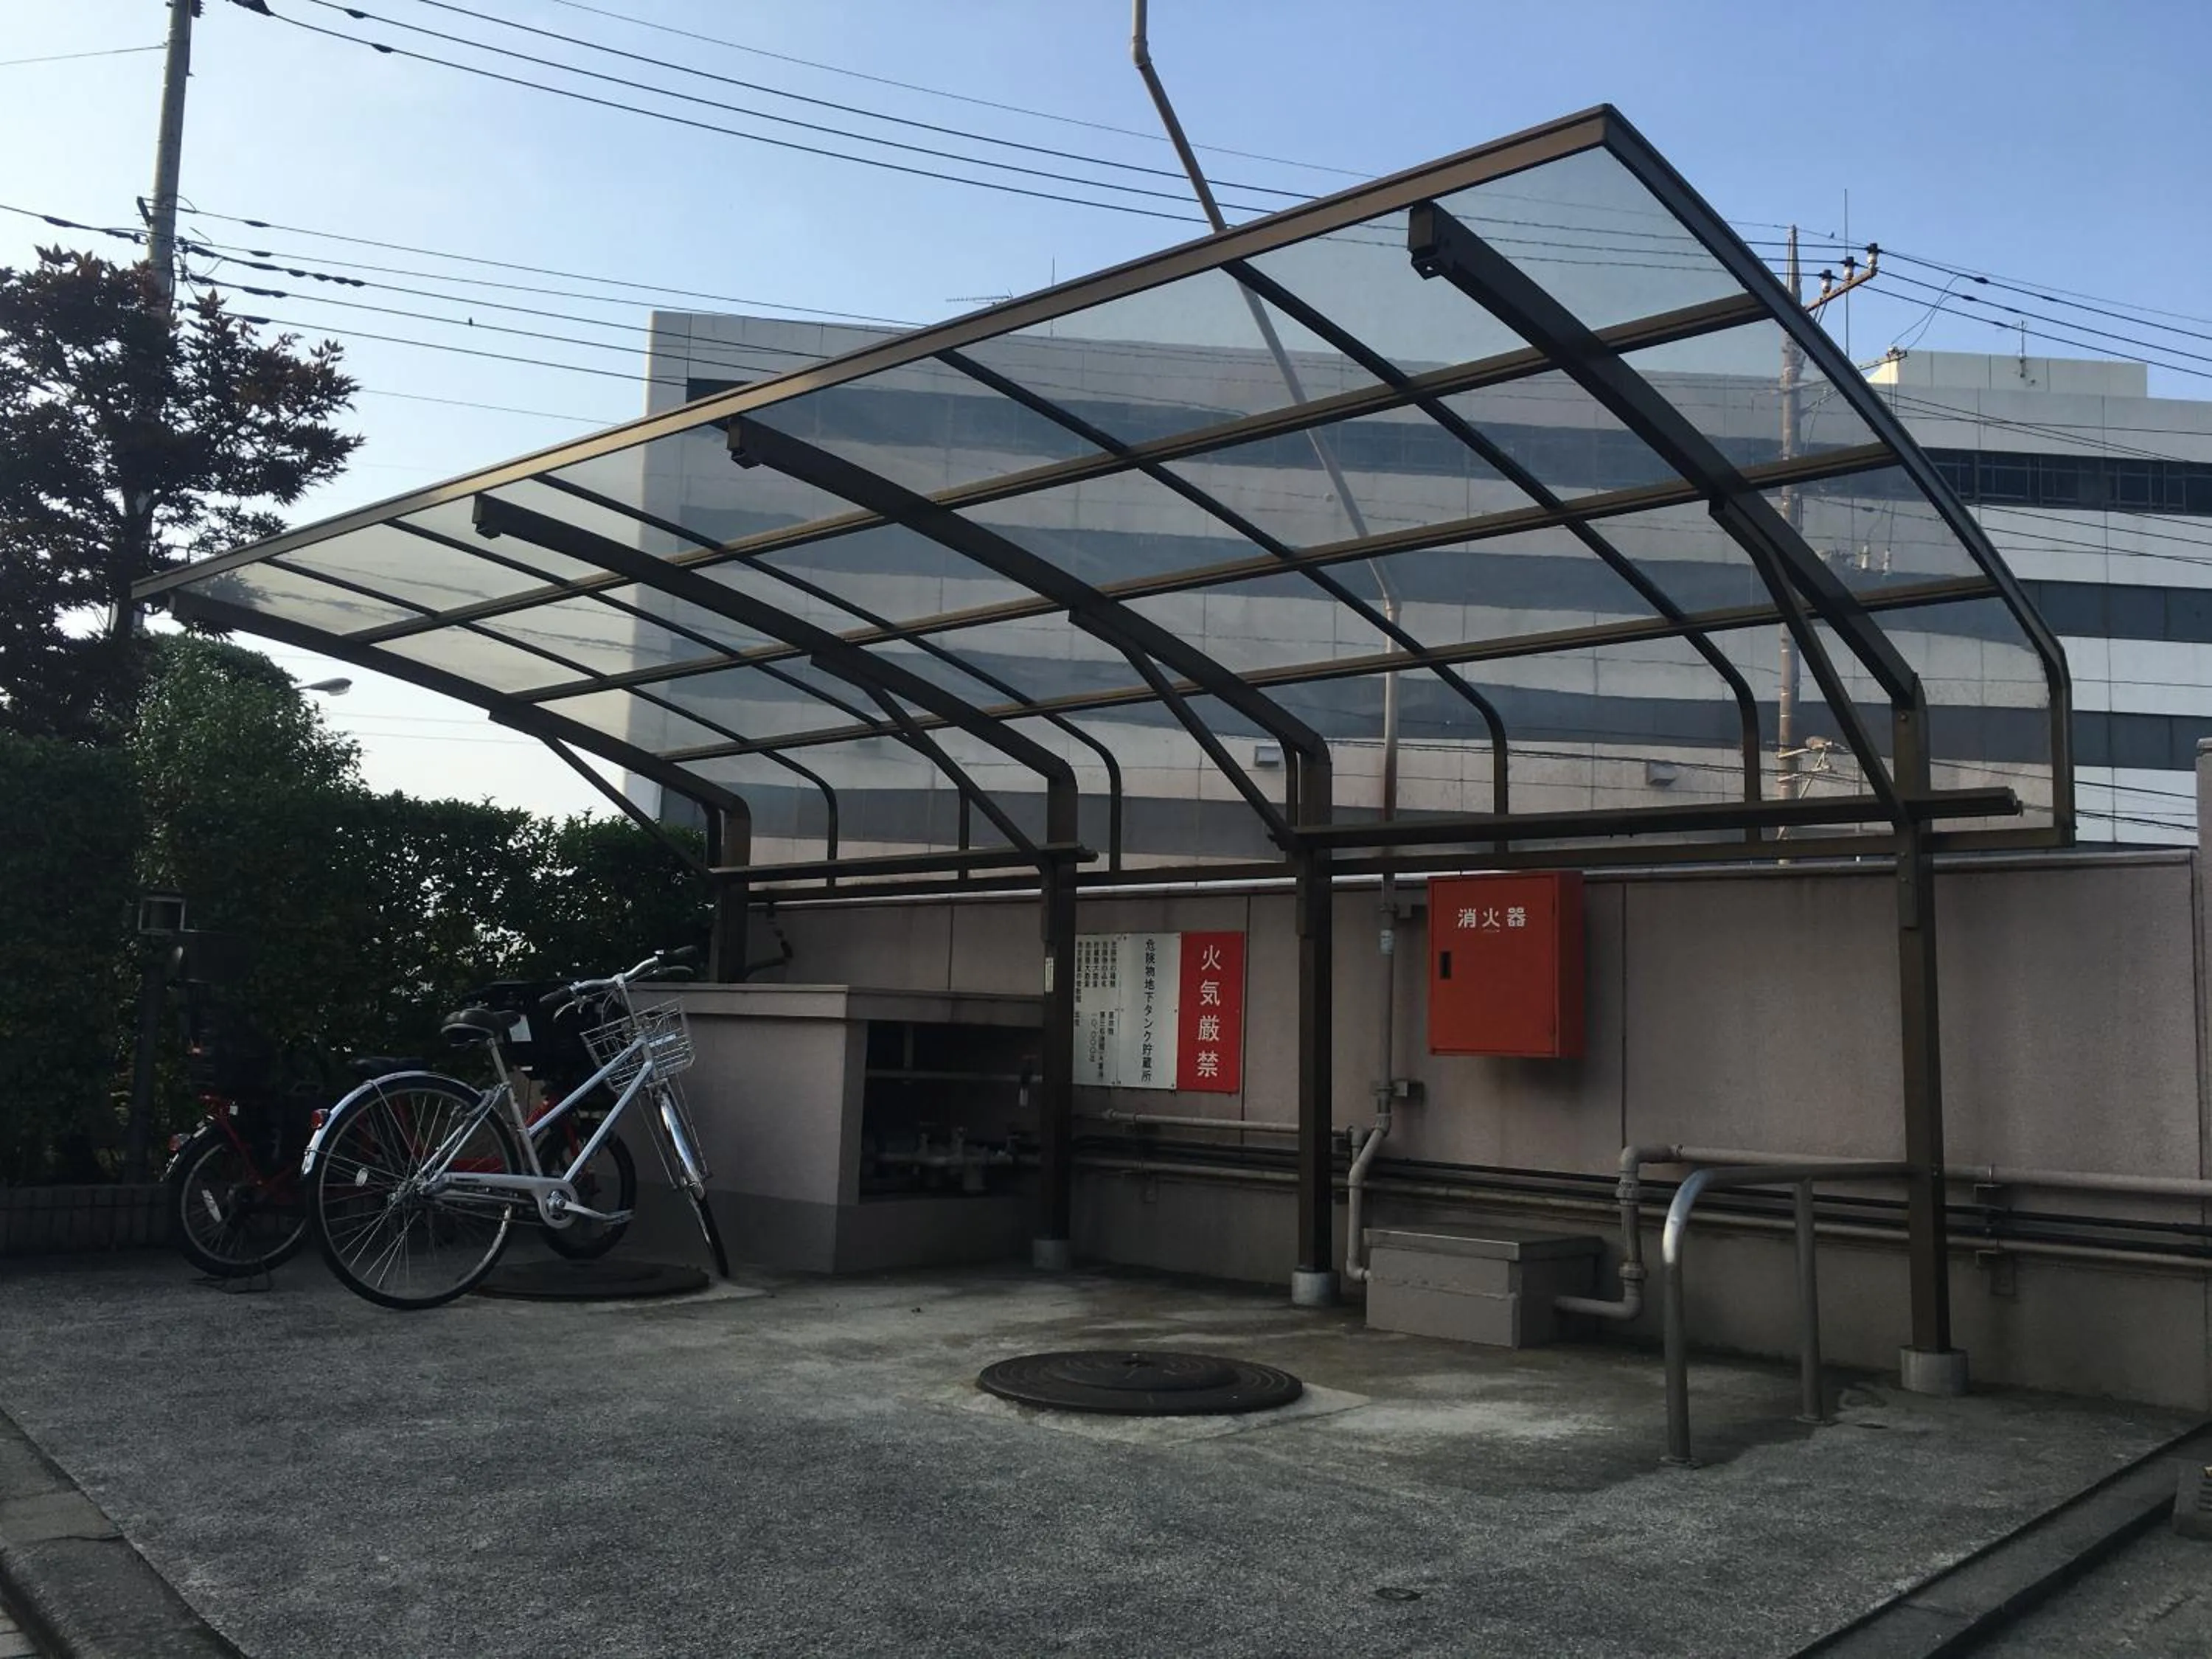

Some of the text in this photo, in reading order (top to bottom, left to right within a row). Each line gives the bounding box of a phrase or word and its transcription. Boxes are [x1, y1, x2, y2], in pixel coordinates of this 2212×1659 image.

[1458, 906, 1526, 928] 消火器
[1141, 938, 1156, 1082] 危険物地下タンク貯蔵所
[1197, 945, 1222, 1077] 火気厳禁
